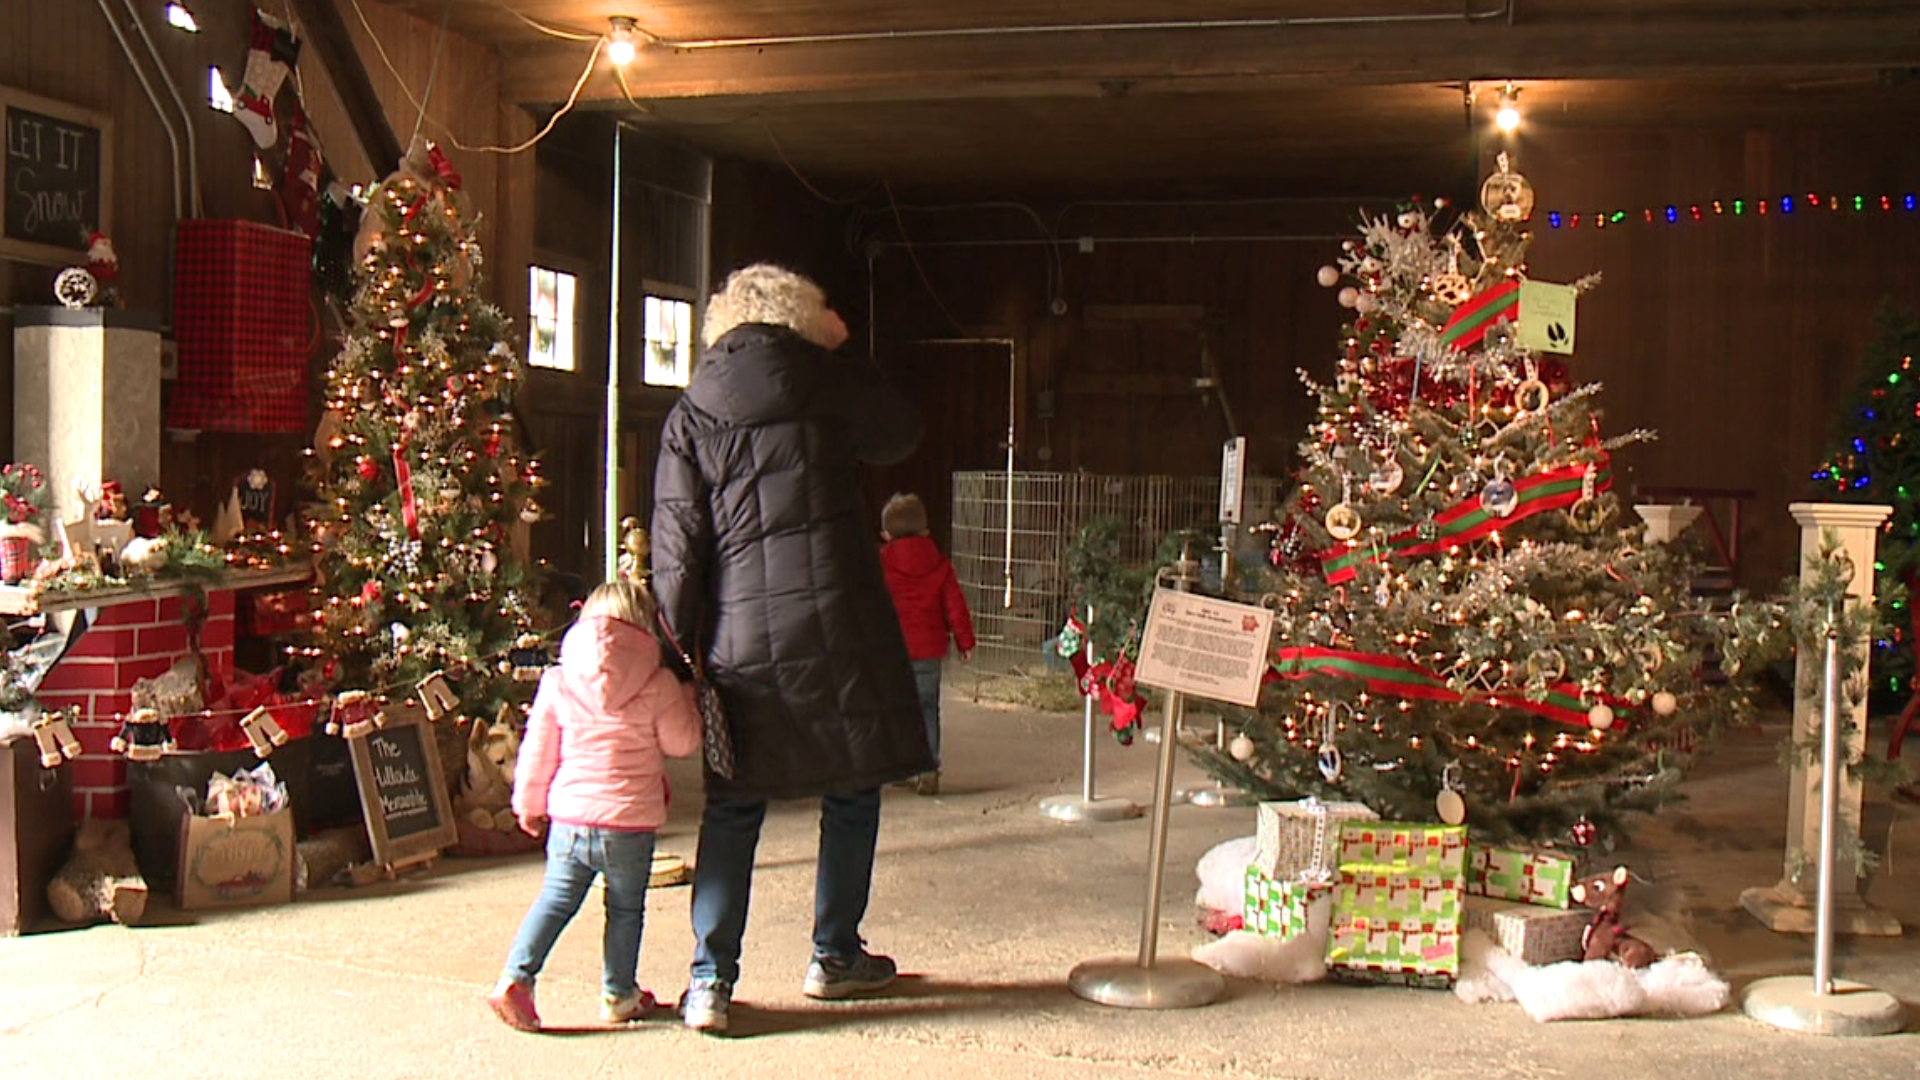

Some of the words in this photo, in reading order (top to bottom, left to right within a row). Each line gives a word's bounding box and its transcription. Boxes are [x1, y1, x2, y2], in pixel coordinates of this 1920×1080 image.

[7, 115, 43, 162] LET
[55, 125, 85, 172] IT
[15, 166, 86, 232] Snow
[241, 491, 270, 512] JOY
[371, 737, 401, 758] The
